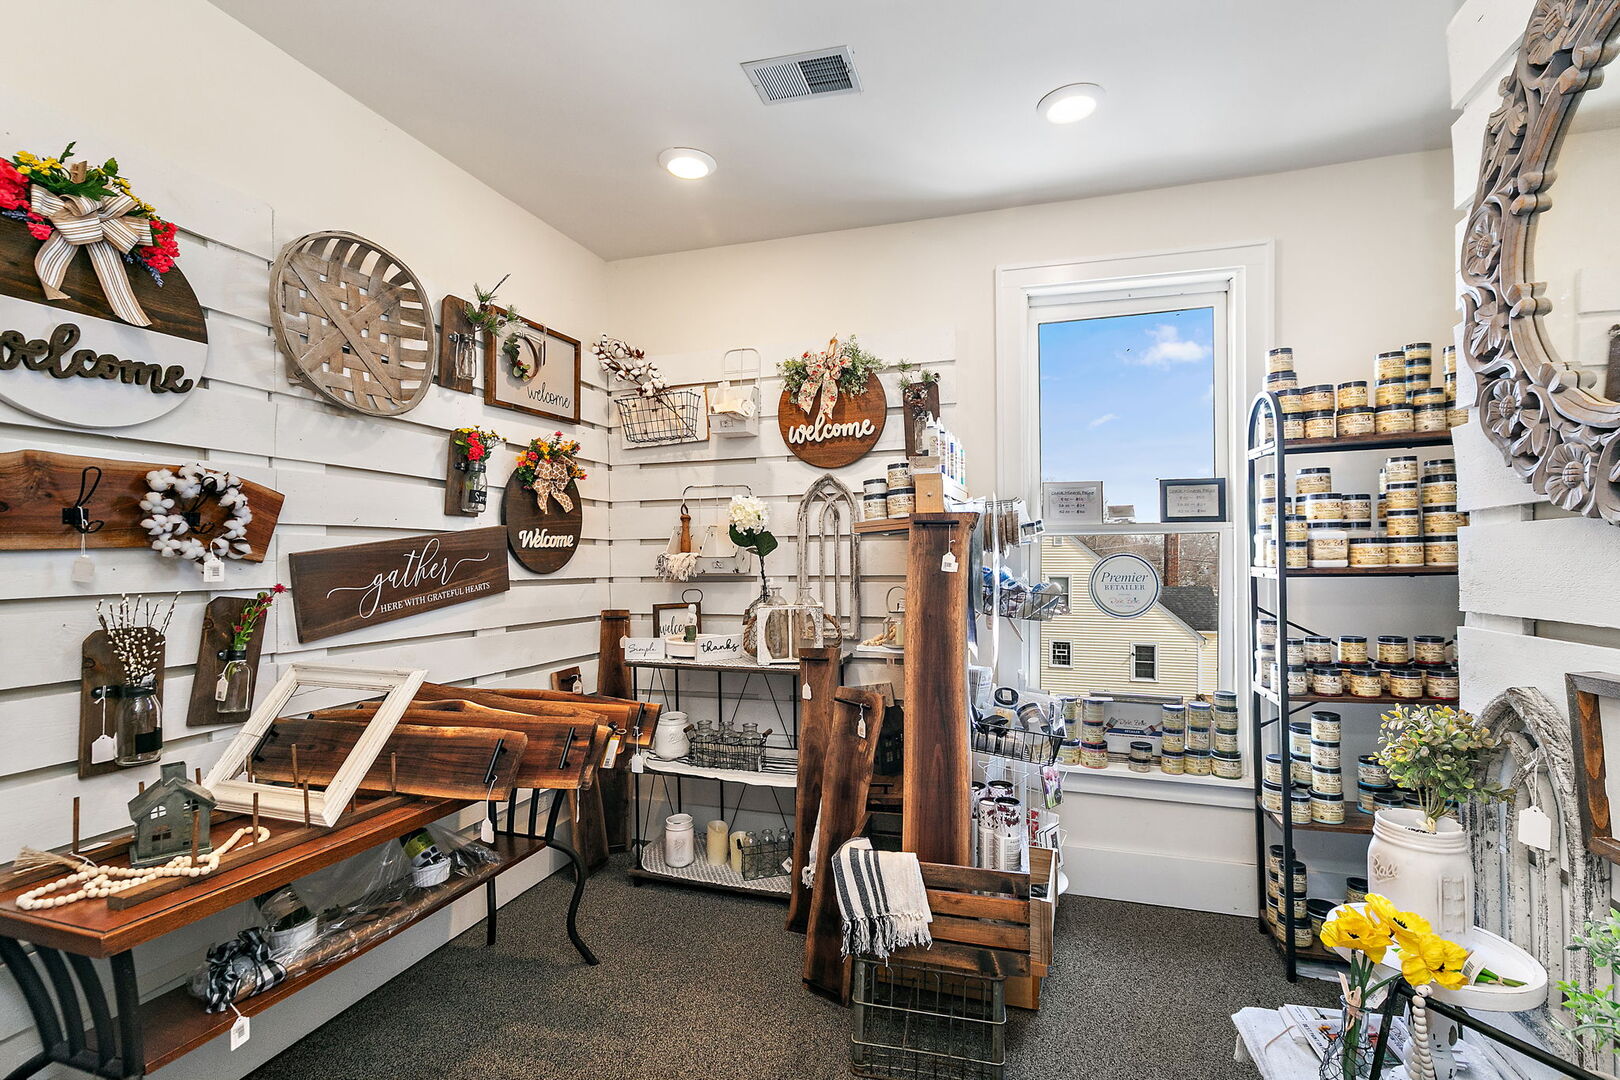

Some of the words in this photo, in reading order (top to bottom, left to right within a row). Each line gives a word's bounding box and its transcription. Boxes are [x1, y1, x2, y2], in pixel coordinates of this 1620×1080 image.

[527, 382, 571, 409] welcome
[788, 414, 875, 444] welcome
[519, 528, 574, 549] Welcome
[326, 538, 490, 619] gather
[1101, 572, 1149, 583] Premier
[380, 602, 404, 614] HERE
[404, 596, 426, 608] WITH
[427, 589, 464, 603] GRATEFUL
[465, 582, 490, 595] HEARTS
[658, 616, 685, 635] welco
[701, 639, 740, 653] thanks
[1372, 854, 1400, 882] Ball
